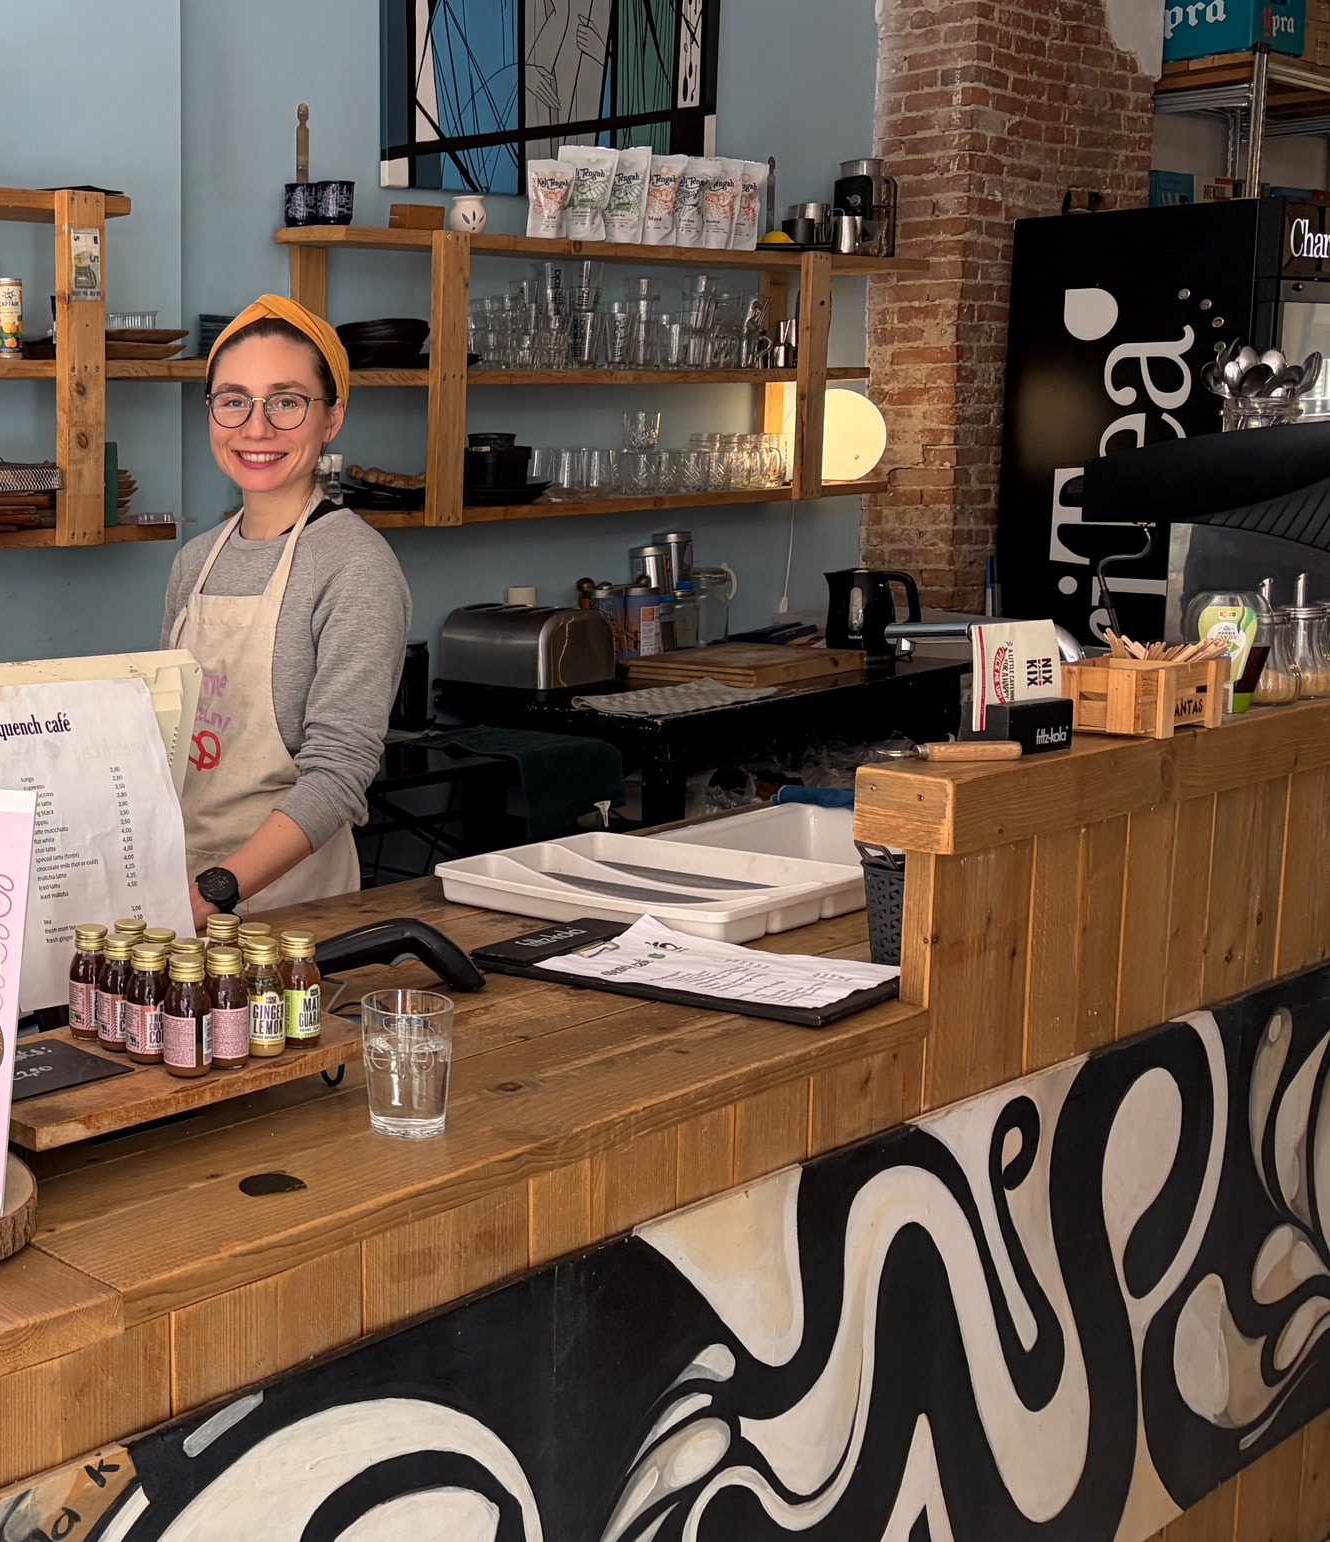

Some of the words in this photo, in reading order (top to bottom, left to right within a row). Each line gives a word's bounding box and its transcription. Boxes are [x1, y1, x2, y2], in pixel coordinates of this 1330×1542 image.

[1164, 0, 1226, 39] pra
[577, 168, 605, 181] Tengah
[45, 712, 72, 734] café
[44, 826, 69, 834] macchiato
[36, 864, 59, 872] chocolate
[37, 874, 54, 882] matcha
[45, 927, 57, 935] fresh
[46, 936, 58, 944] fresh
[59, 934, 74, 943] ginger
[252, 1003, 284, 1019] GINGER
[253, 1019, 283, 1035] LEMON
